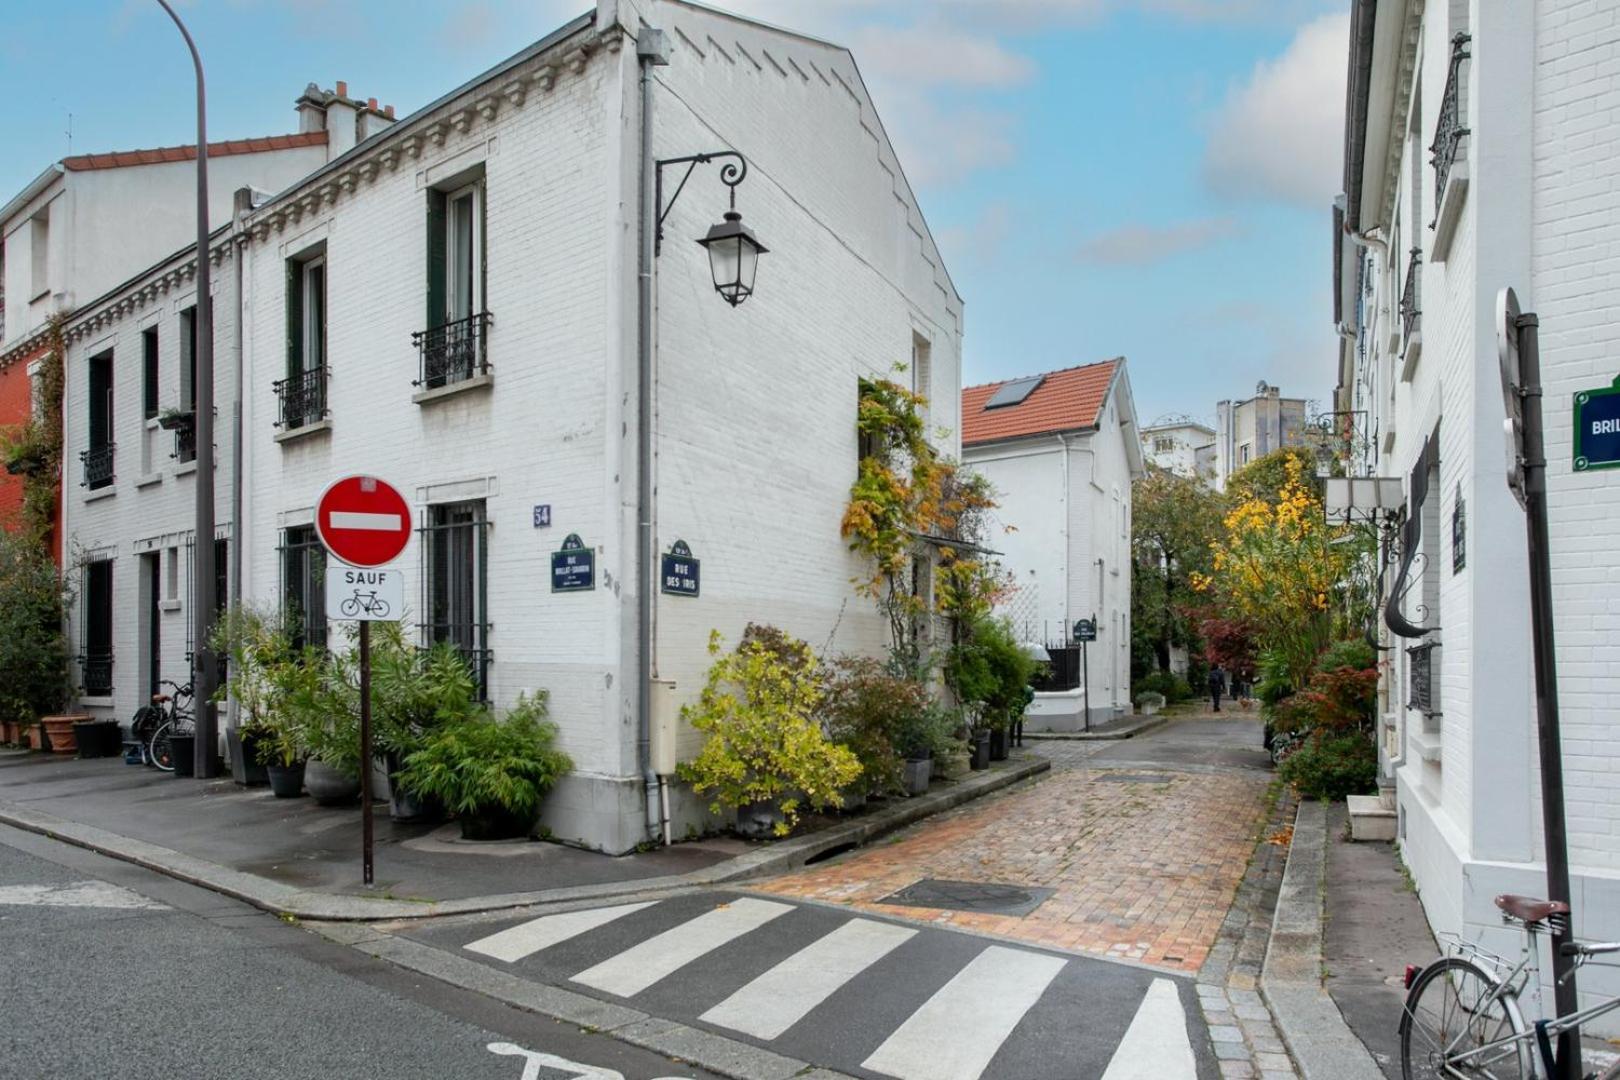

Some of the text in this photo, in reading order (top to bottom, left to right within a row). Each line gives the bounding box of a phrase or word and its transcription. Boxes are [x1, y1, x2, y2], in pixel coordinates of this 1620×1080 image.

[536, 506, 549, 525] 54
[675, 563, 689, 575] RUE
[345, 571, 387, 585] SAUF
[666, 576, 696, 590] DES IRIS
